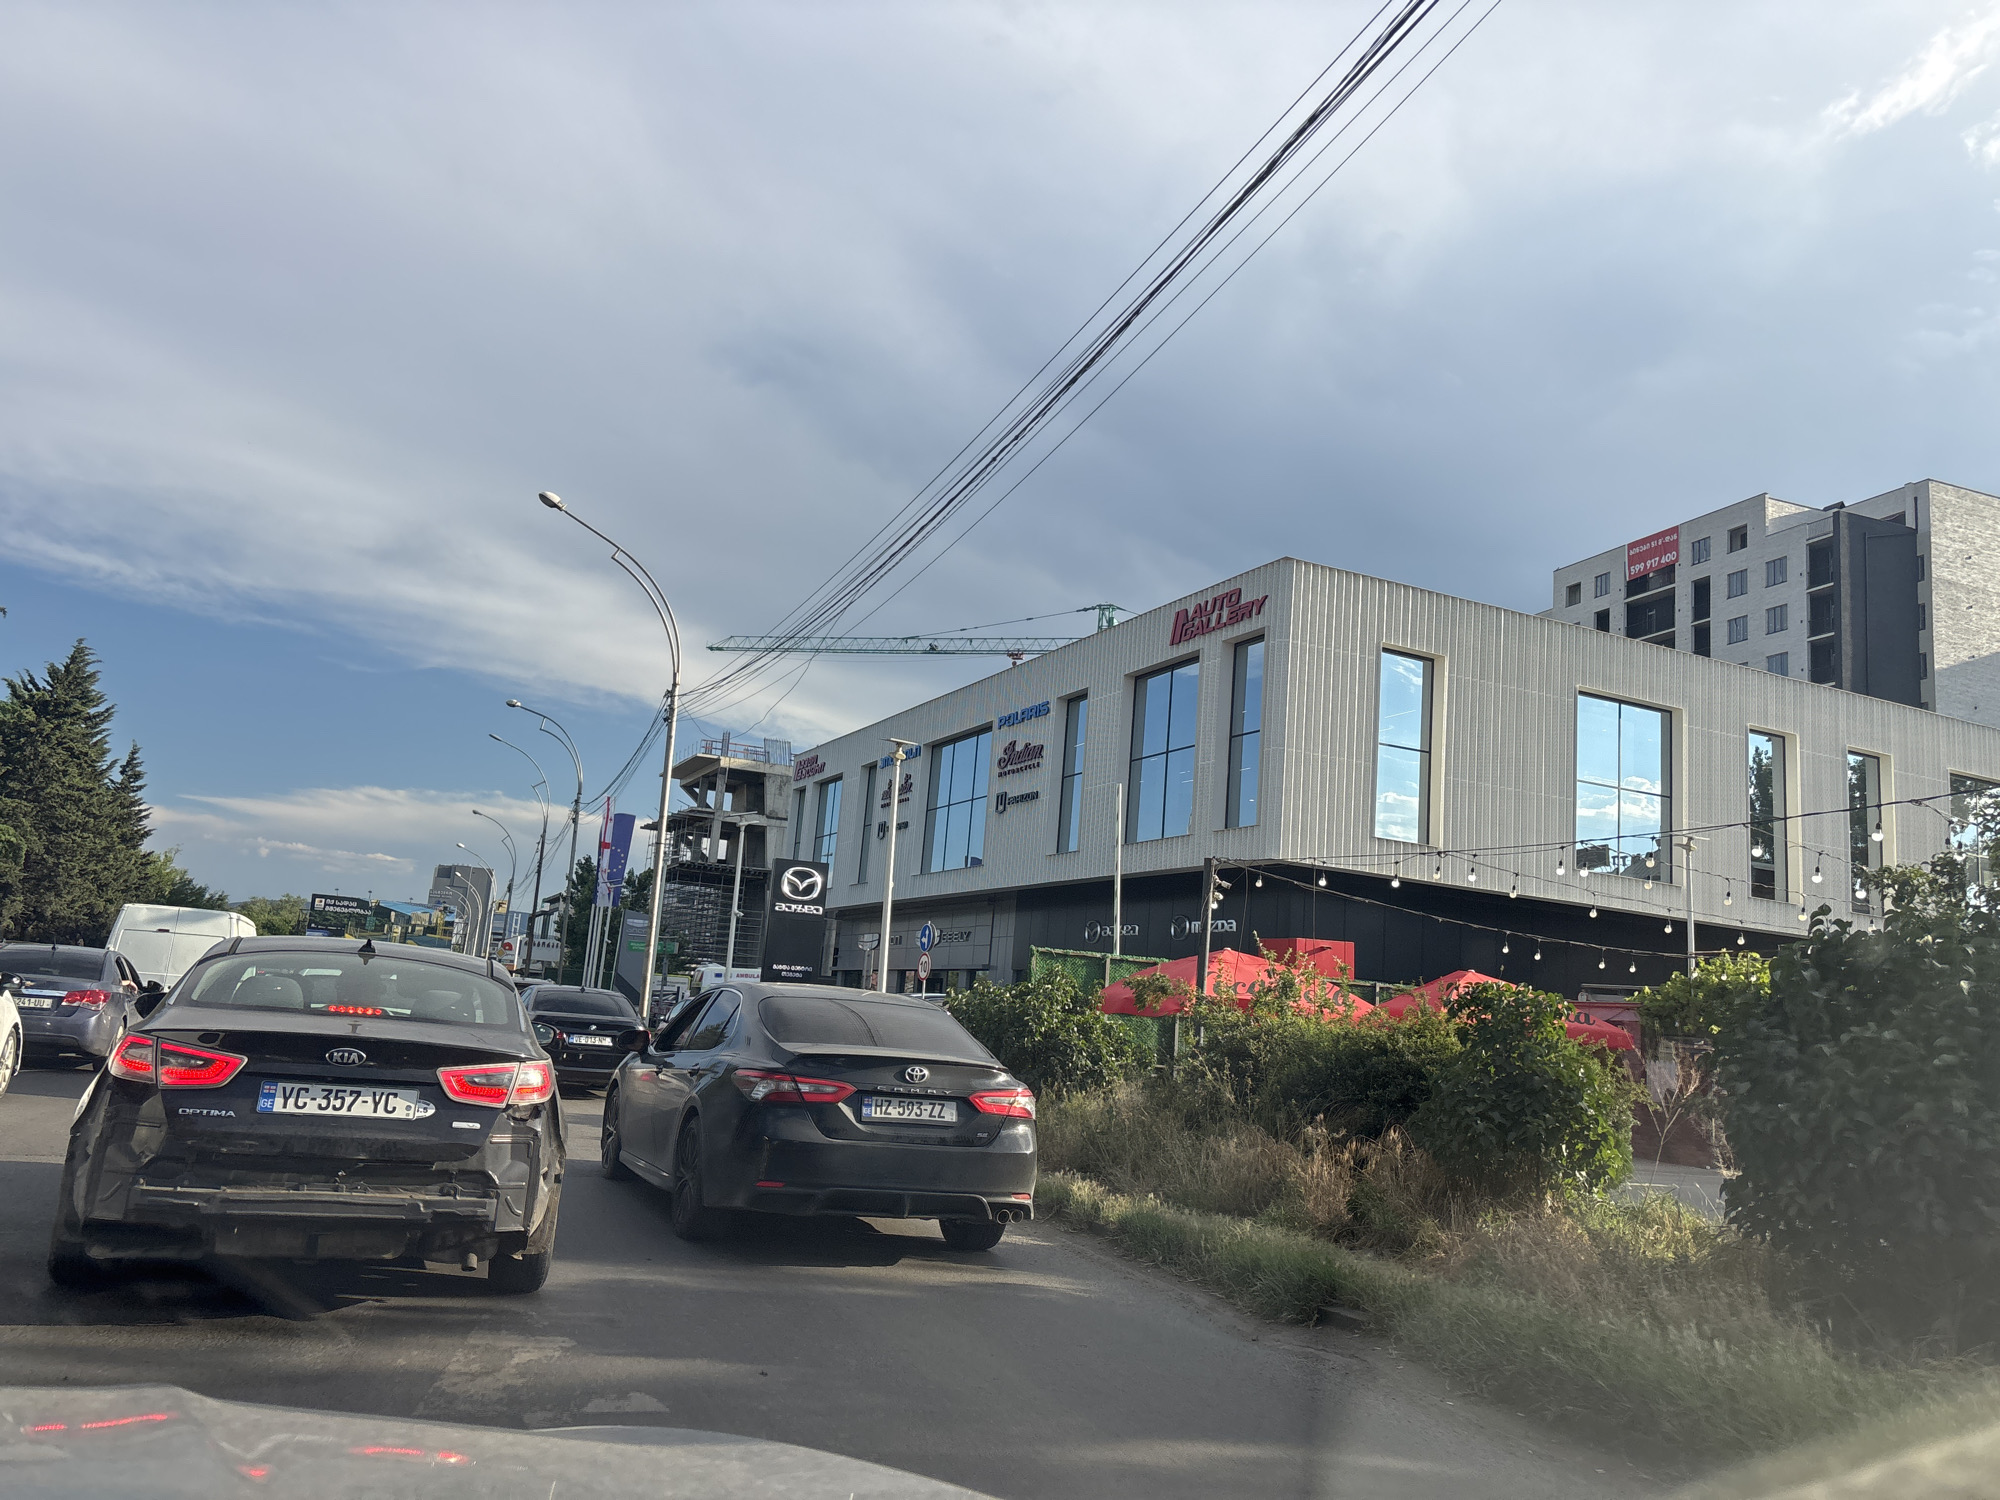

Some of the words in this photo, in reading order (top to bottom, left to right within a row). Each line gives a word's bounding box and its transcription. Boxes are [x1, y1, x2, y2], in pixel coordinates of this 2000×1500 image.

[1630, 562, 1645, 575] 599
[1646, 556, 1660, 570] 917
[1661, 551, 1677, 564] 400
[1189, 587, 1242, 623] AUTO
[1181, 595, 1269, 643] GALLERY
[997, 700, 1050, 730] POLARIS
[997, 740, 1044, 770] Indian
[998, 761, 1041, 778] MOTORCYCLE
[1007, 791, 1039, 806] FARIZON
[920, 960, 928, 973] 10
[16, 998, 45, 1007] 241-UU
[332, 1051, 360, 1065] KIA
[877, 1085, 952, 1095] CAMRY
[260, 1098, 274, 1109] GE
[281, 1086, 399, 1114] YC-357-YC
[874, 1098, 946, 1119] HZ-593-ZZ
[178, 1108, 236, 1118] OPTIMA
